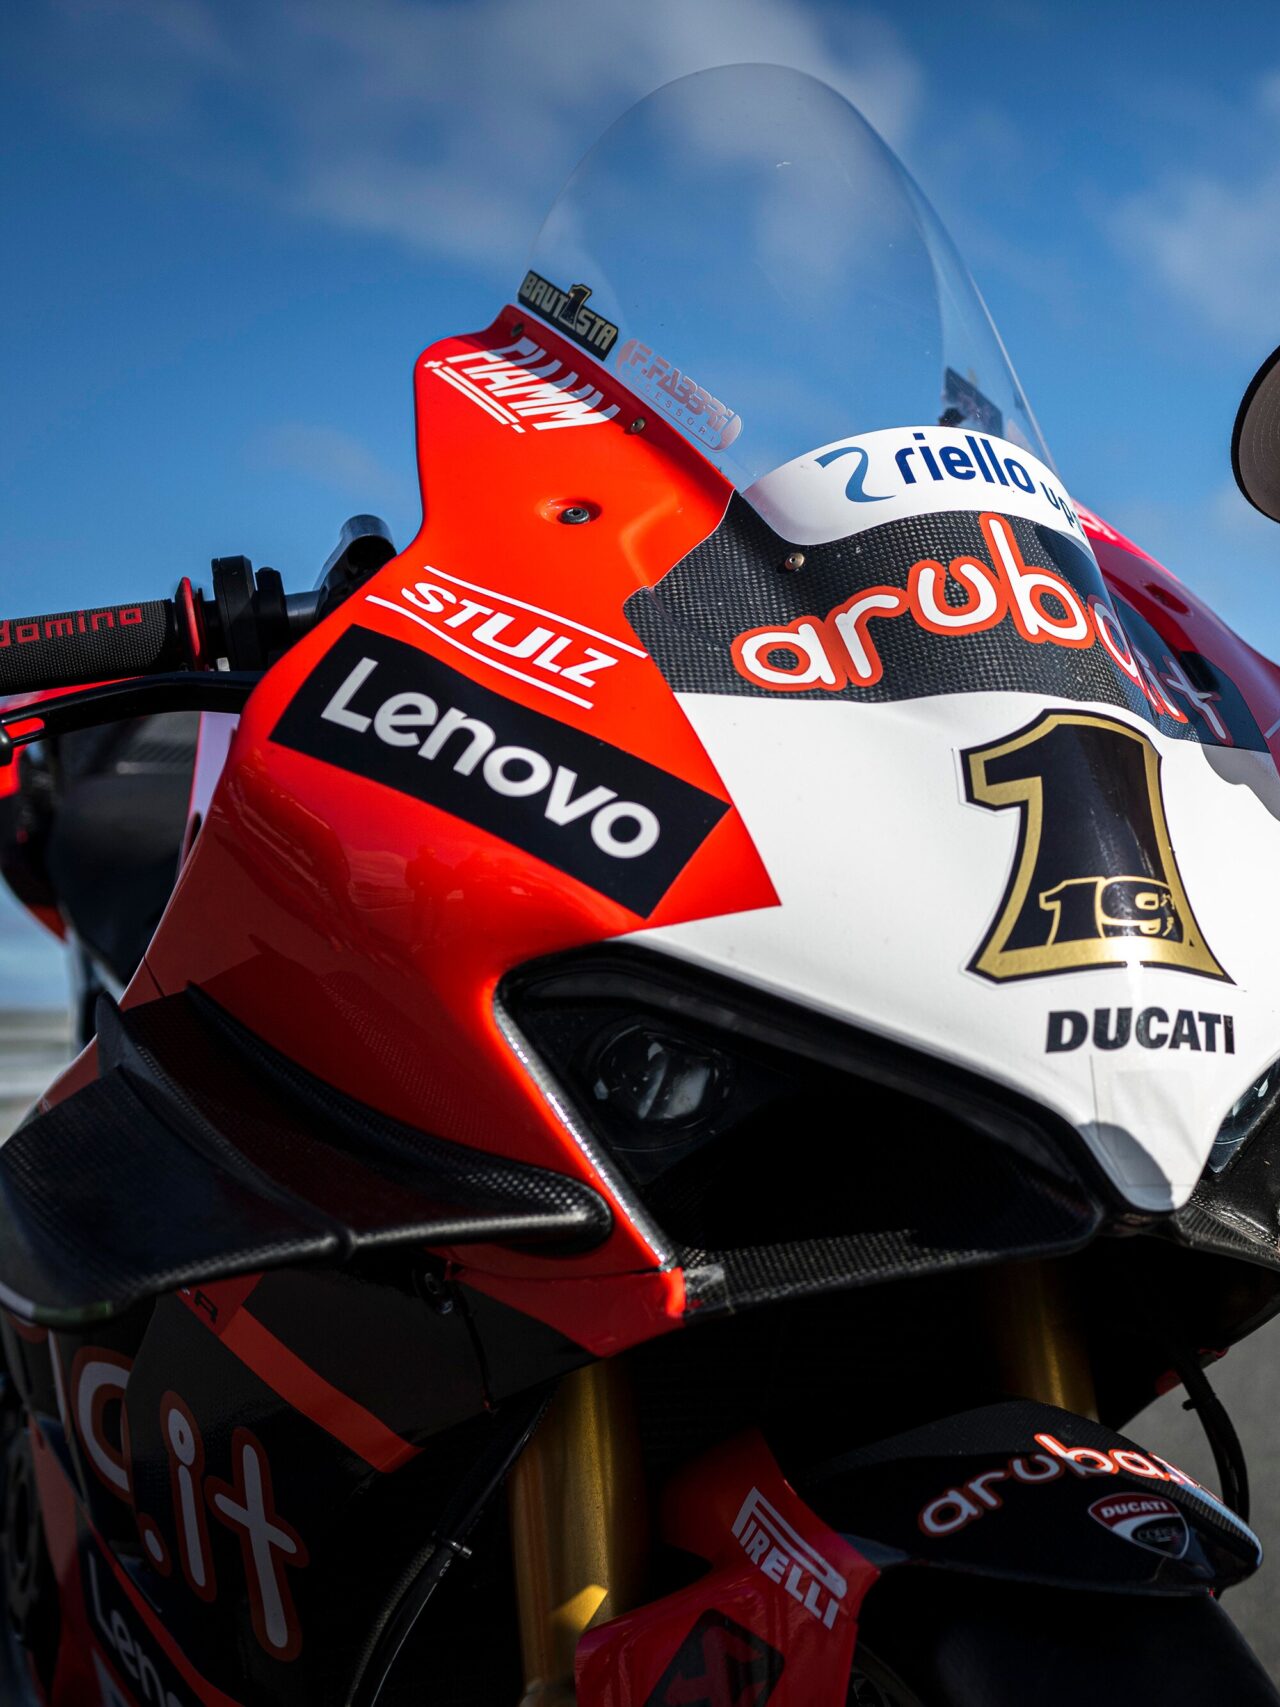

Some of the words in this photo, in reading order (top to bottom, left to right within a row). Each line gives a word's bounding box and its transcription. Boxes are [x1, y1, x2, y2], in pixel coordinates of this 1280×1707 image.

[446, 336, 621, 431] FIAMM
[894, 433, 1036, 494] riello
[400, 582, 618, 688] STULZ
[320, 657, 661, 860] Lenovo
[965, 708, 1238, 986] 1
[1045, 1006, 1236, 1054] DUCATI
[731, 1487, 848, 1630] PIRELLI
[1100, 1499, 1169, 1519] DUCATI
